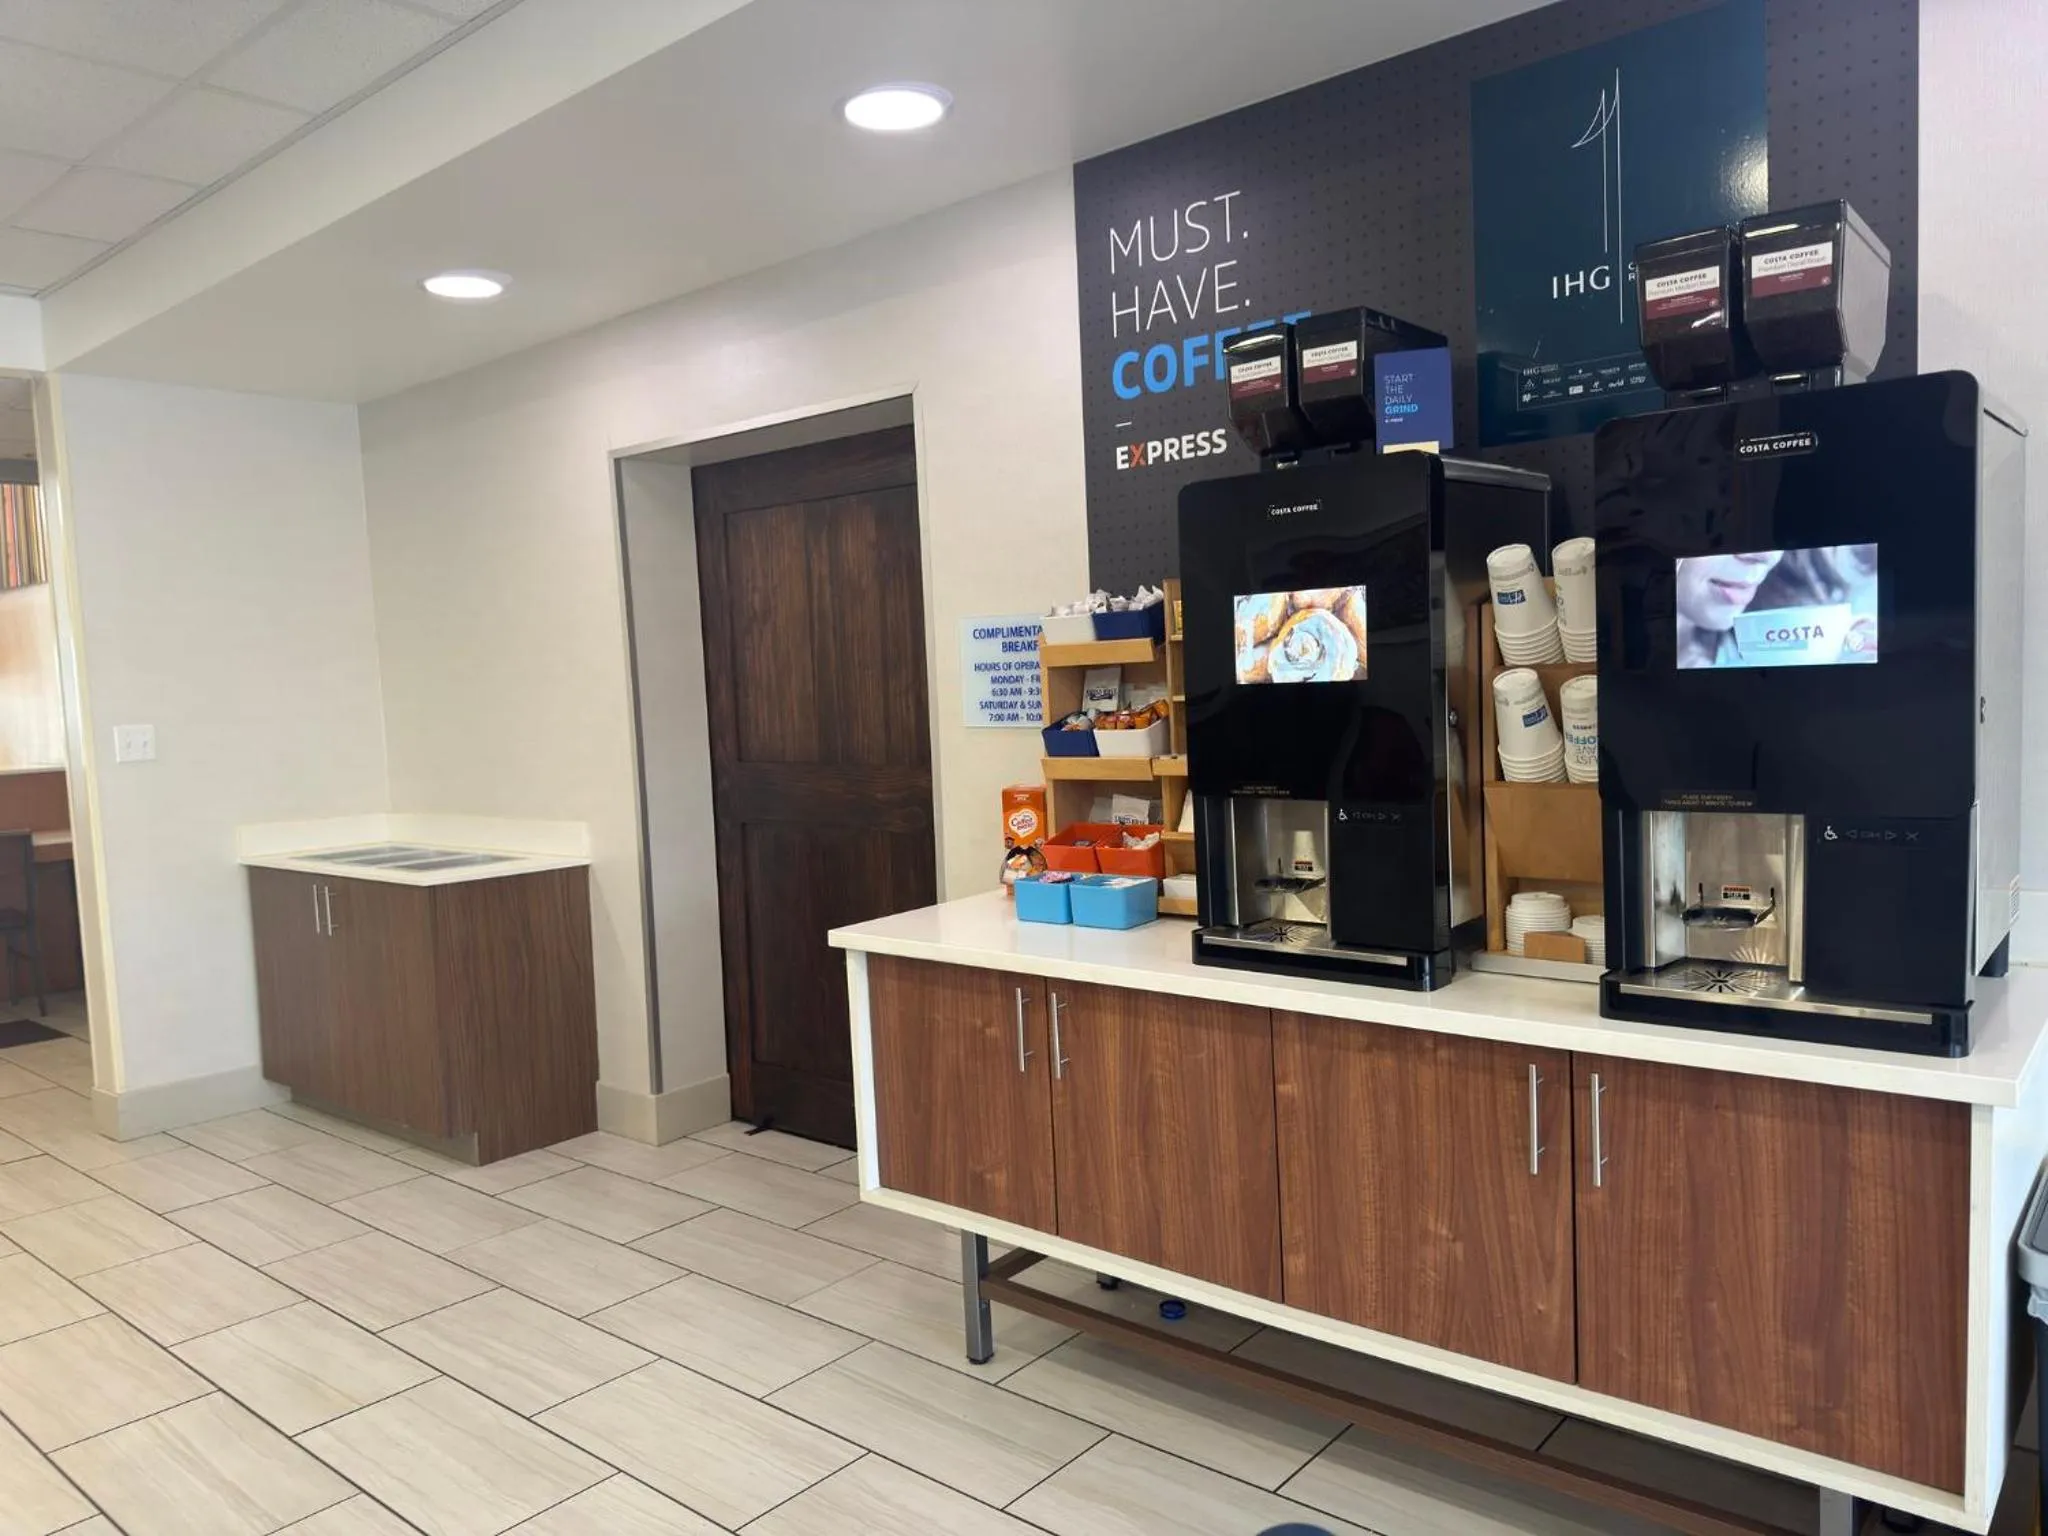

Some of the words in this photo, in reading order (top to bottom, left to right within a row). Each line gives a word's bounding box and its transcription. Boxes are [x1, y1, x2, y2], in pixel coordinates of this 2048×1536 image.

[1110, 190, 1249, 275] MUST.
[1764, 255, 1787, 264] COSTA
[1789, 249, 1818, 259] COFFEE
[1553, 265, 1610, 299] IHG
[1656, 279, 1678, 288] COSTA
[1680, 272, 1707, 282] COFFEE
[1112, 260, 1251, 338] HAVE.
[1384, 373, 1414, 384] START
[1385, 384, 1404, 395] THE
[1384, 394, 1413, 405] DAILY
[1384, 403, 1419, 415] GRIND
[1116, 428, 1227, 470] EXPRESS
[1740, 443, 1770, 454] COSTA
[1773, 437, 1812, 450] COFFEE
[973, 625, 1043, 640] COMPLIMENTA
[1766, 625, 1824, 643] COSTA
[1001, 640, 1039, 653] BREAKF
[974, 662, 1002, 672] HOURS
[1002, 661, 1013, 671] OF
[1014, 661, 1041, 670] OPERA
[990, 674, 1025, 684] MONDAY
[992, 687, 1008, 697] 6:30
[1009, 687, 1022, 696] AM
[1028, 687, 1042, 696] 9:3
[979, 700, 1018, 710] SATURDAY
[1019, 700, 1026, 709] &
[1027, 700, 1042, 709] SUN
[989, 713, 1005, 722] 7:00
[1006, 713, 1020, 722] AM
[1026, 712, 1042, 721] 10:0
